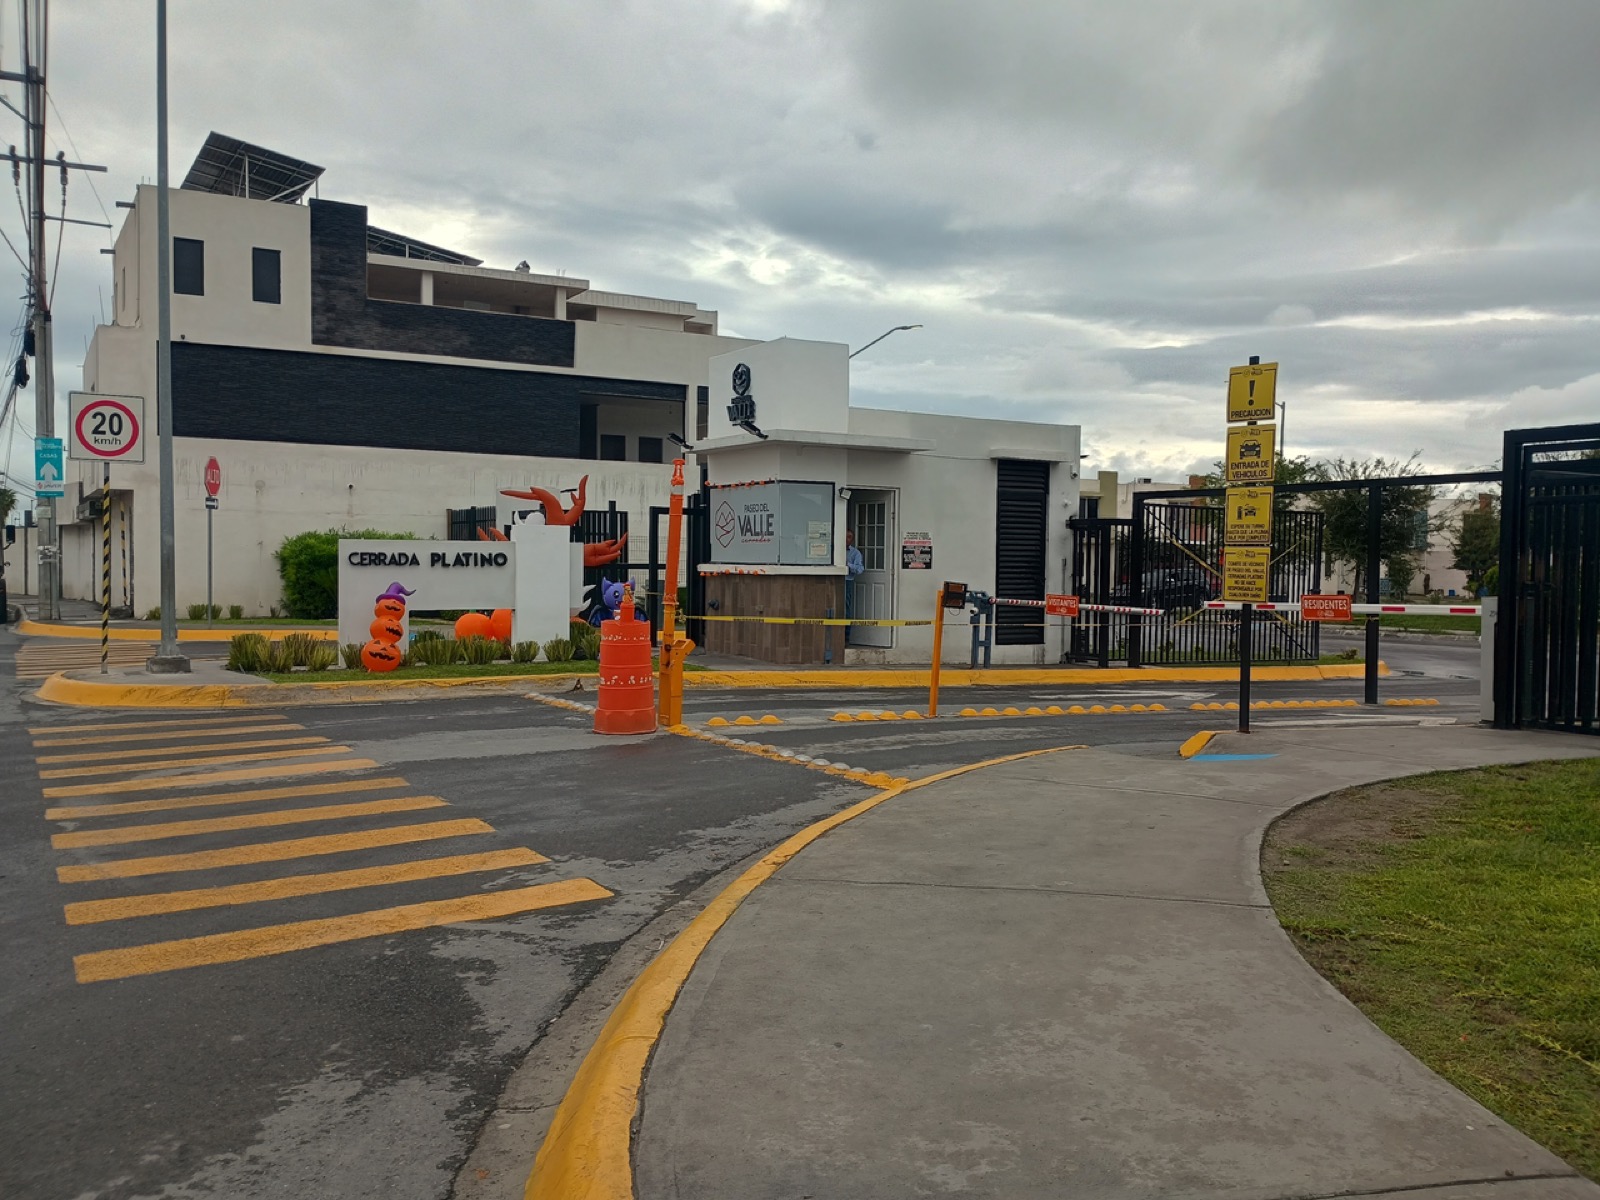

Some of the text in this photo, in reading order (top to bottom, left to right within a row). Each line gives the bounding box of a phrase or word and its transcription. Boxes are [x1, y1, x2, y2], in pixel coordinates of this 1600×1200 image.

[1231, 408, 1271, 418] PRECAUCION
[91, 411, 123, 436] 20
[94, 436, 122, 445] km/h
[1231, 459, 1270, 470] ENTRADA DE
[1232, 470, 1268, 479] VEHICULOS
[744, 502, 770, 513] PASEO DEL
[737, 513, 775, 537] VALLE
[348, 552, 508, 567] CERRADA PLATINO
[1304, 599, 1347, 610] RESIDENTES
